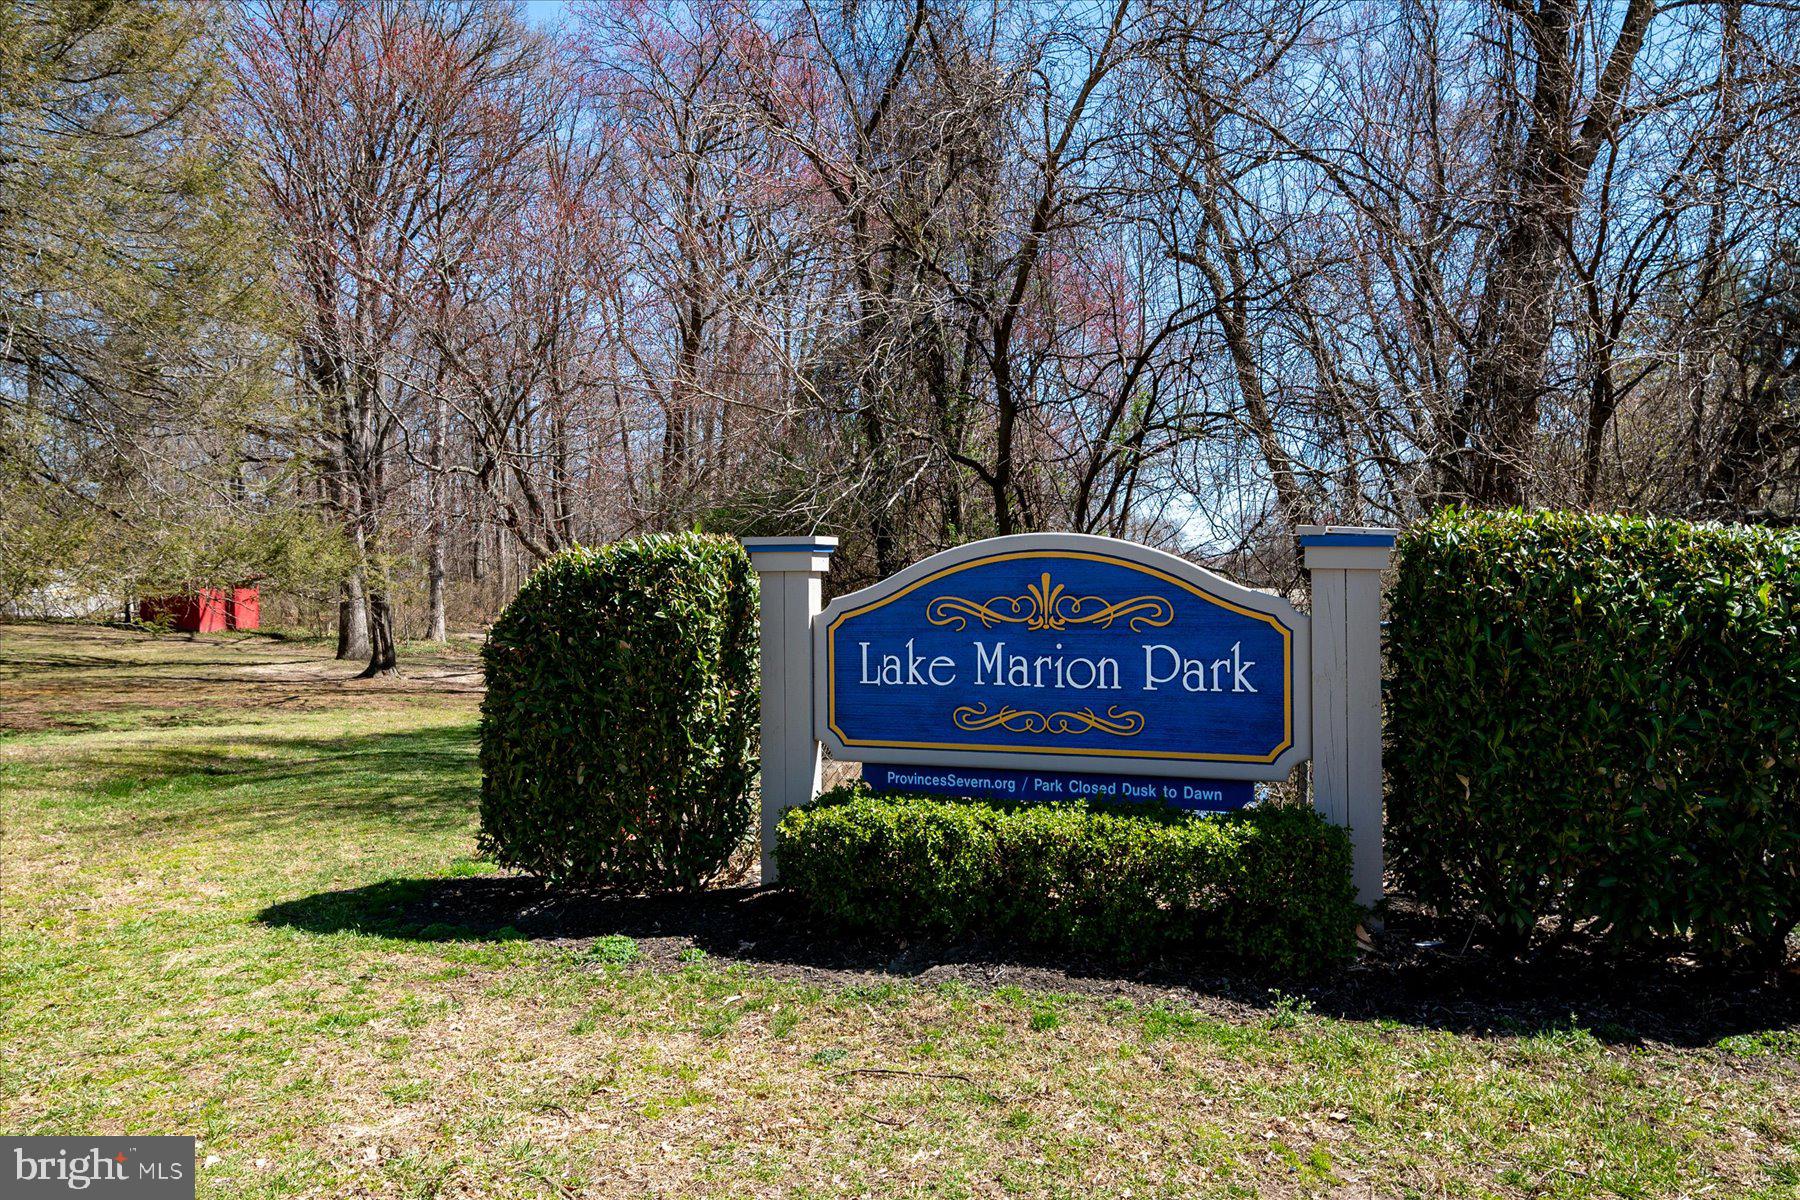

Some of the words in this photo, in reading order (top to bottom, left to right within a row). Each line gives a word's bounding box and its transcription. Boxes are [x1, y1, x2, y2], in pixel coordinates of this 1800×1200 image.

[859, 637, 956, 686] Lake
[973, 641, 1122, 690] Marion
[1142, 640, 1258, 693] Park
[887, 771, 1016, 792] ProvincesSevern.org
[1021, 777, 1028, 792] /
[1034, 778, 1063, 793] Park
[1069, 780, 1116, 795] Closed
[1122, 782, 1157, 797] Dusk
[1163, 785, 1177, 798] to
[1184, 786, 1222, 801] Dawn
